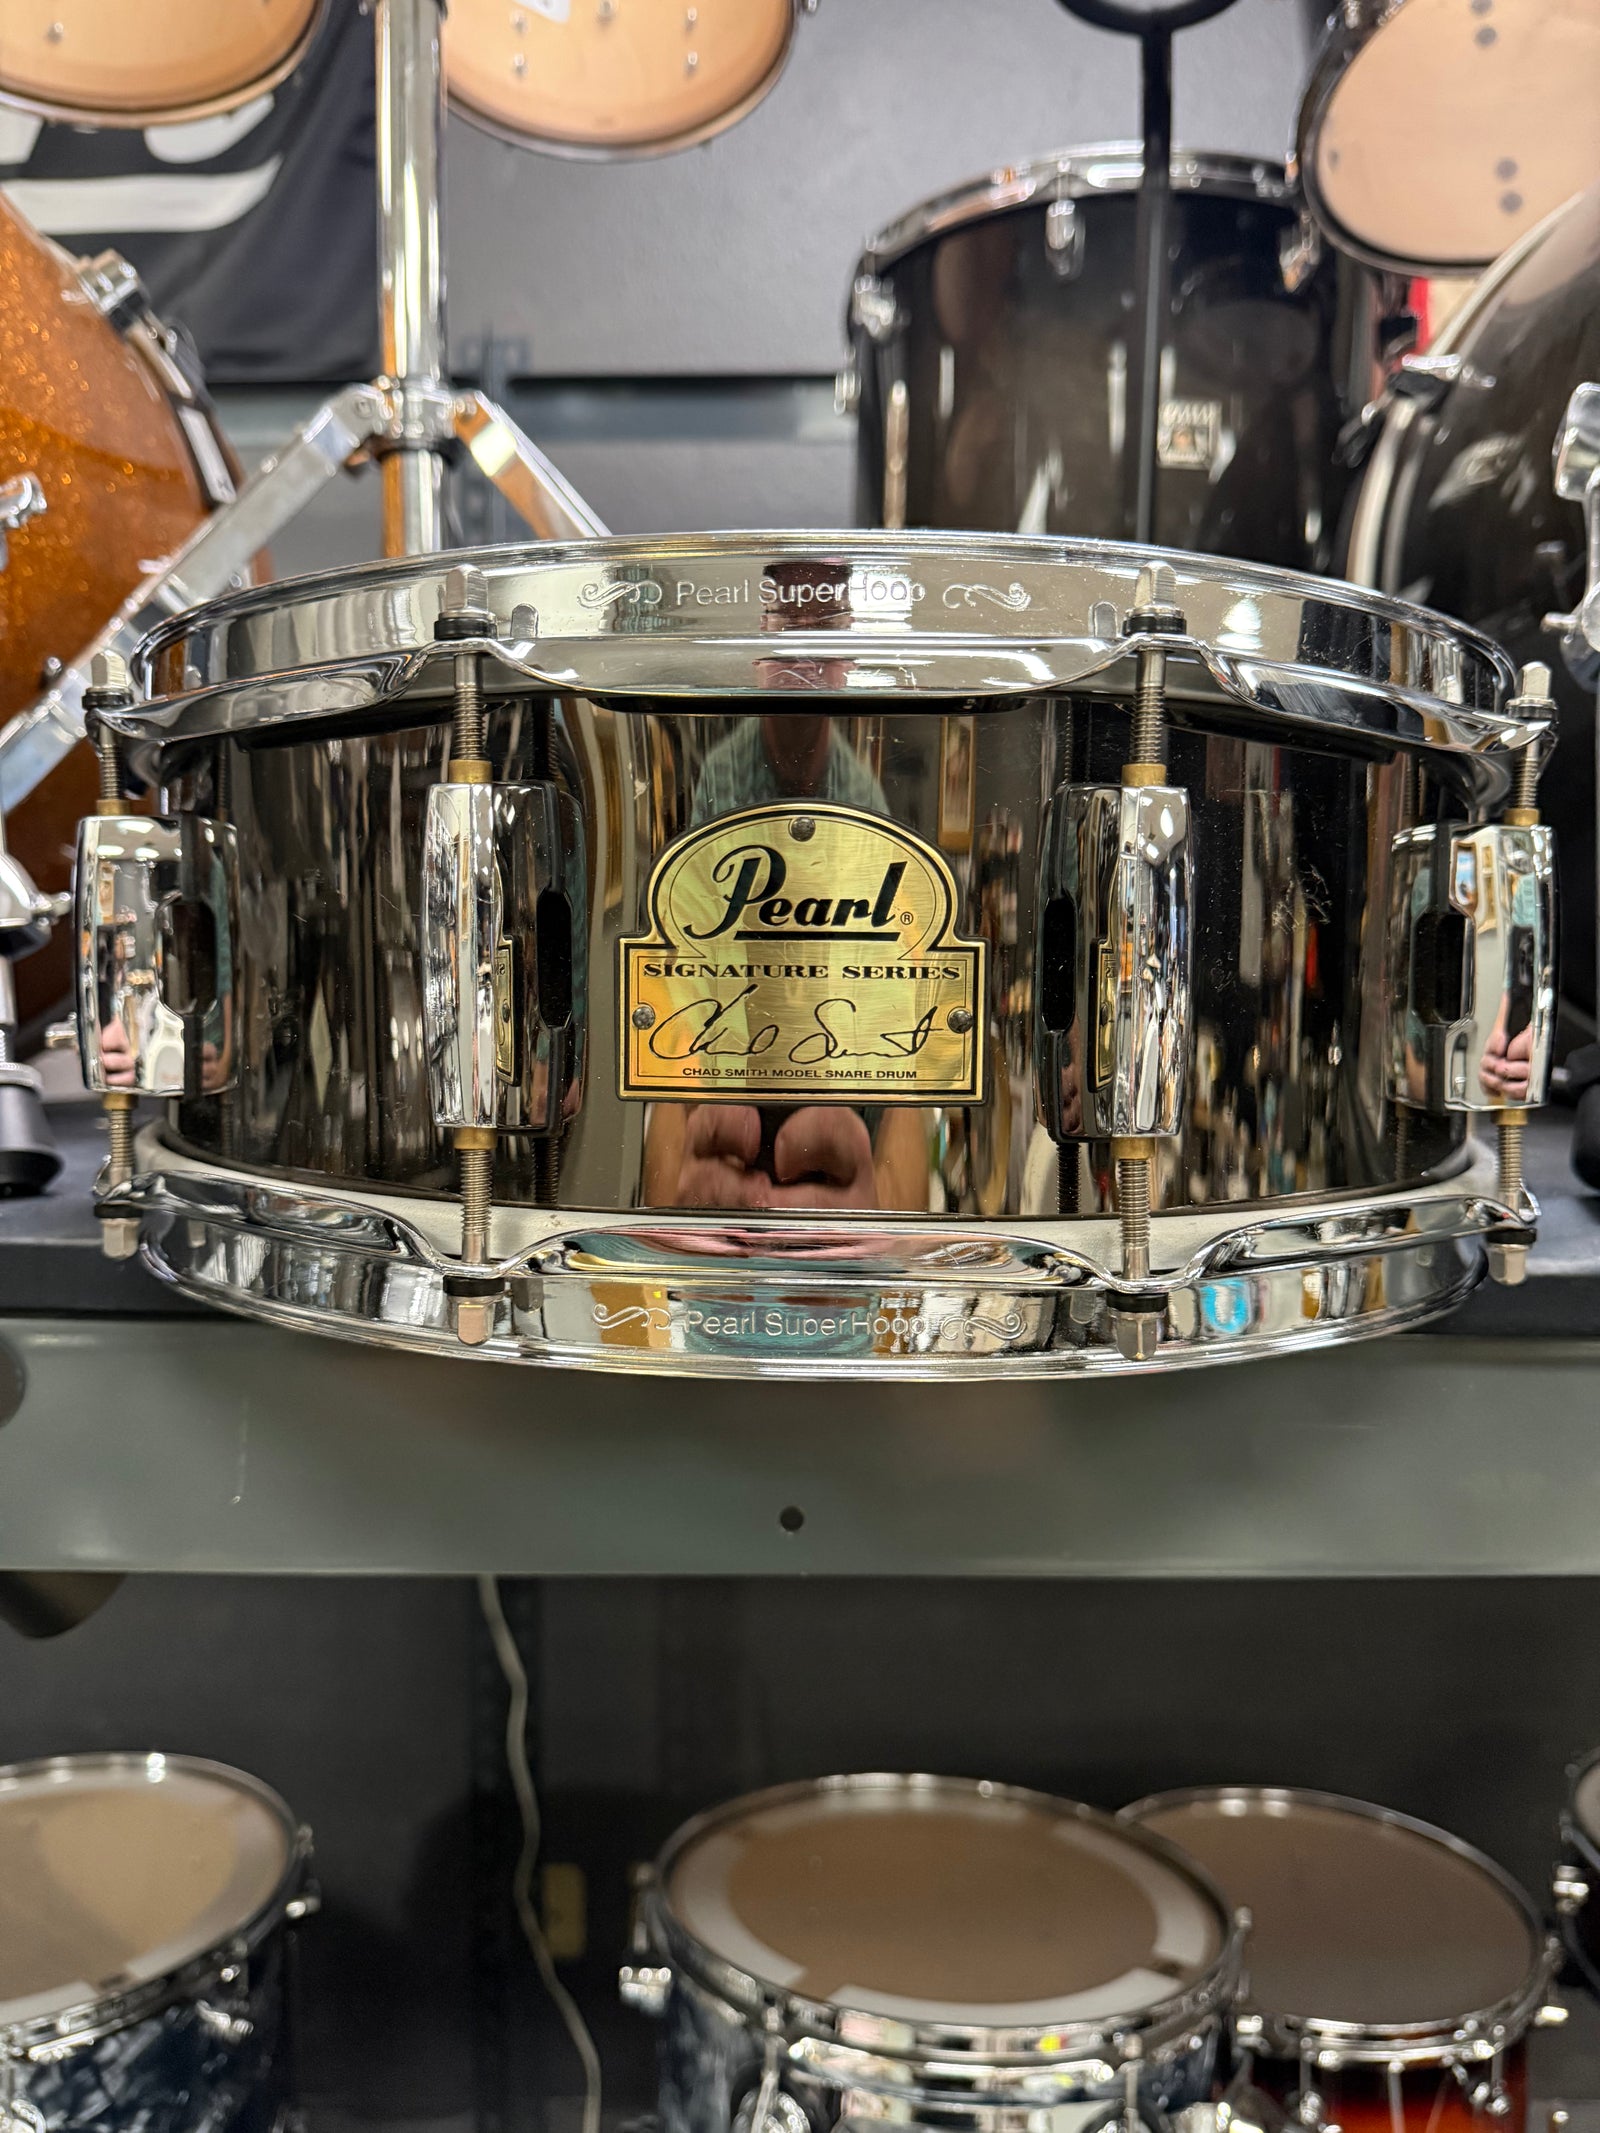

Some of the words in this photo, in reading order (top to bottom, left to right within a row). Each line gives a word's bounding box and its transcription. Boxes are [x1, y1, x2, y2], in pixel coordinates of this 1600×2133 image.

[676, 579, 749, 606] Pearl
[643, 963, 828, 979] SIGNATURE
[842, 965, 961, 980] SERIES
[682, 1067, 721, 1077] CHAD
[724, 1068, 768, 1077] SMITH
[772, 1069, 821, 1079] MODEL
[825, 1069, 872, 1079] SNARE
[876, 1070, 917, 1079] DRUM
[684, 1310, 755, 1335] Pearl
